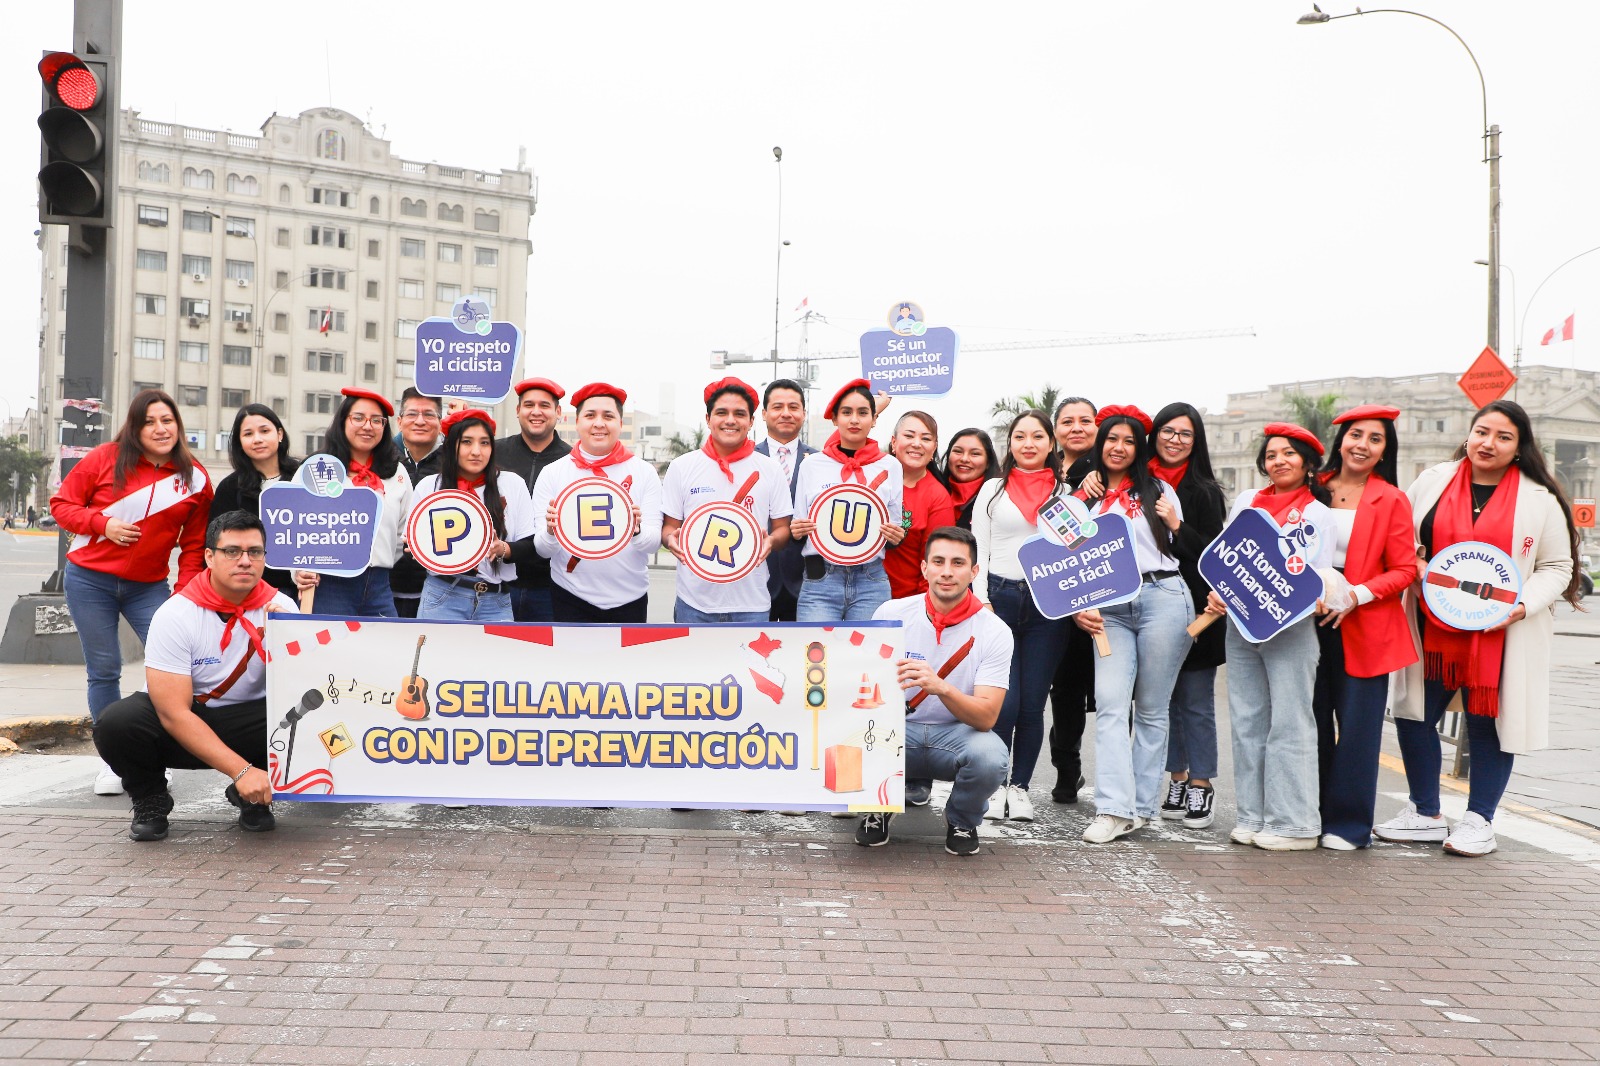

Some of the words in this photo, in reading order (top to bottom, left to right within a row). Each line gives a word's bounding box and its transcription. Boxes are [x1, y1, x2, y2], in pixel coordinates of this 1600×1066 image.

[421, 338, 445, 354] YO
[449, 339, 511, 357] respeto
[887, 339, 905, 352] Sé
[908, 340, 926, 350] un
[428, 356, 444, 372] al
[447, 356, 502, 372] ciclista
[873, 352, 942, 366] conductor
[867, 363, 950, 381] responsable
[1469, 370, 1505, 380] DISMINUIR
[442, 384, 461, 393] SAT
[889, 384, 906, 393] SAT
[1467, 381, 1505, 391] VELOCIDAD
[690, 486, 700, 495] SAT
[265, 508, 294, 525] YO
[298, 509, 369, 529] respeto
[274, 528, 292, 545] al
[296, 528, 360, 549] peatón
[429, 506, 471, 556] P
[576, 493, 615, 541] E
[698, 513, 743, 568] R
[829, 498, 872, 547] U
[292, 555, 314, 565] SAT
[1031, 554, 1079, 581] Ahora
[1080, 536, 1125, 566] pagar
[1234, 537, 1260, 559] ¡Si
[1252, 552, 1294, 598] tomas
[1440, 559, 1455, 571] LA
[1453, 551, 1495, 566] FRANJA
[1494, 563, 1511, 584] QUE
[1058, 575, 1078, 591] es
[1078, 560, 1115, 583] fácil
[1213, 539, 1239, 567] NO
[1232, 563, 1292, 624] manejes!
[1217, 580, 1235, 598] SAT
[1070, 594, 1090, 609] SAT
[1434, 590, 1462, 619] SALVA
[1465, 603, 1500, 620] VIDAS
[192, 658, 204, 666] SAT
[436, 679, 489, 718] SE
[493, 681, 632, 719] LLAMA
[635, 674, 742, 720] PERÚ
[363, 726, 448, 764] CON
[454, 728, 484, 765] P
[487, 729, 543, 766] DE
[546, 722, 799, 770] PREVENCIÓN
